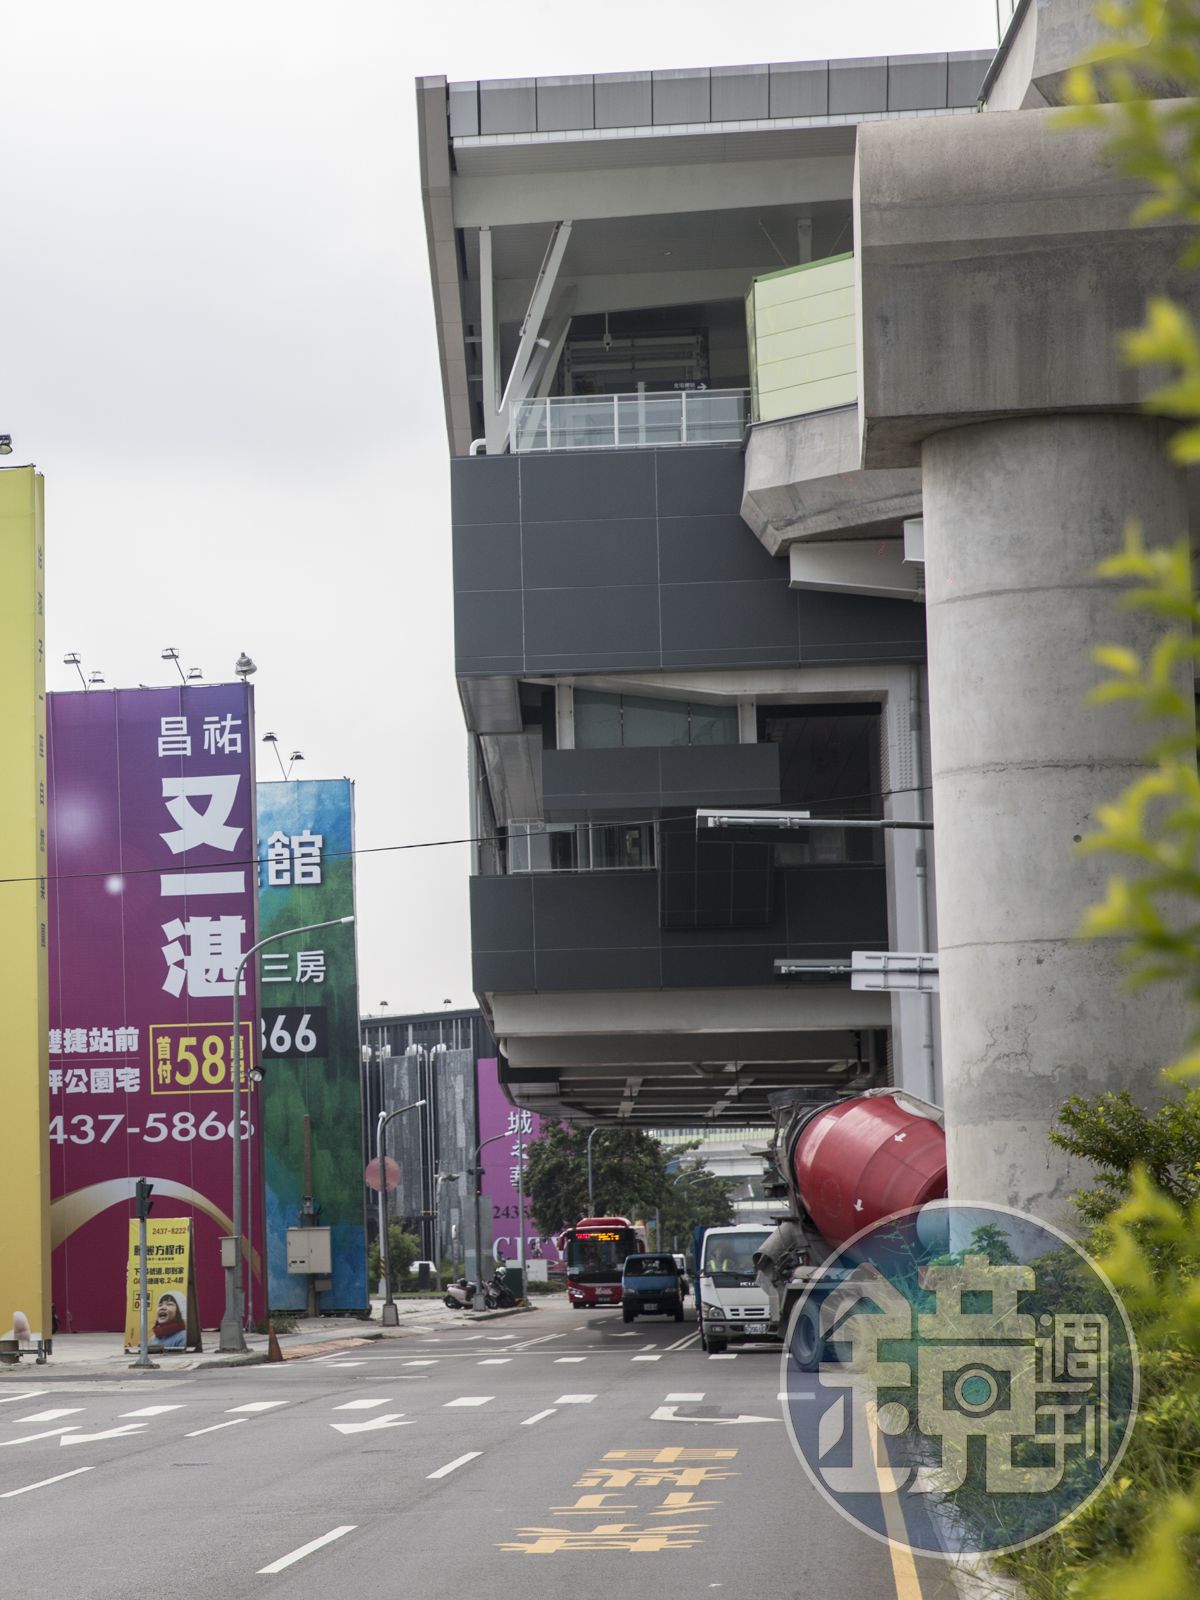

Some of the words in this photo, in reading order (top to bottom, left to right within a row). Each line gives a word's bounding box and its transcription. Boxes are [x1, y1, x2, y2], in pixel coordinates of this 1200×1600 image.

[158, 713, 243, 757] 昌祐
[258, 830, 323, 886] 館
[159, 774, 247, 999] 又一湛
[261, 950, 326, 983] 三房
[156, 1036, 172, 1084] 首付
[175, 1035, 226, 1086] 58
